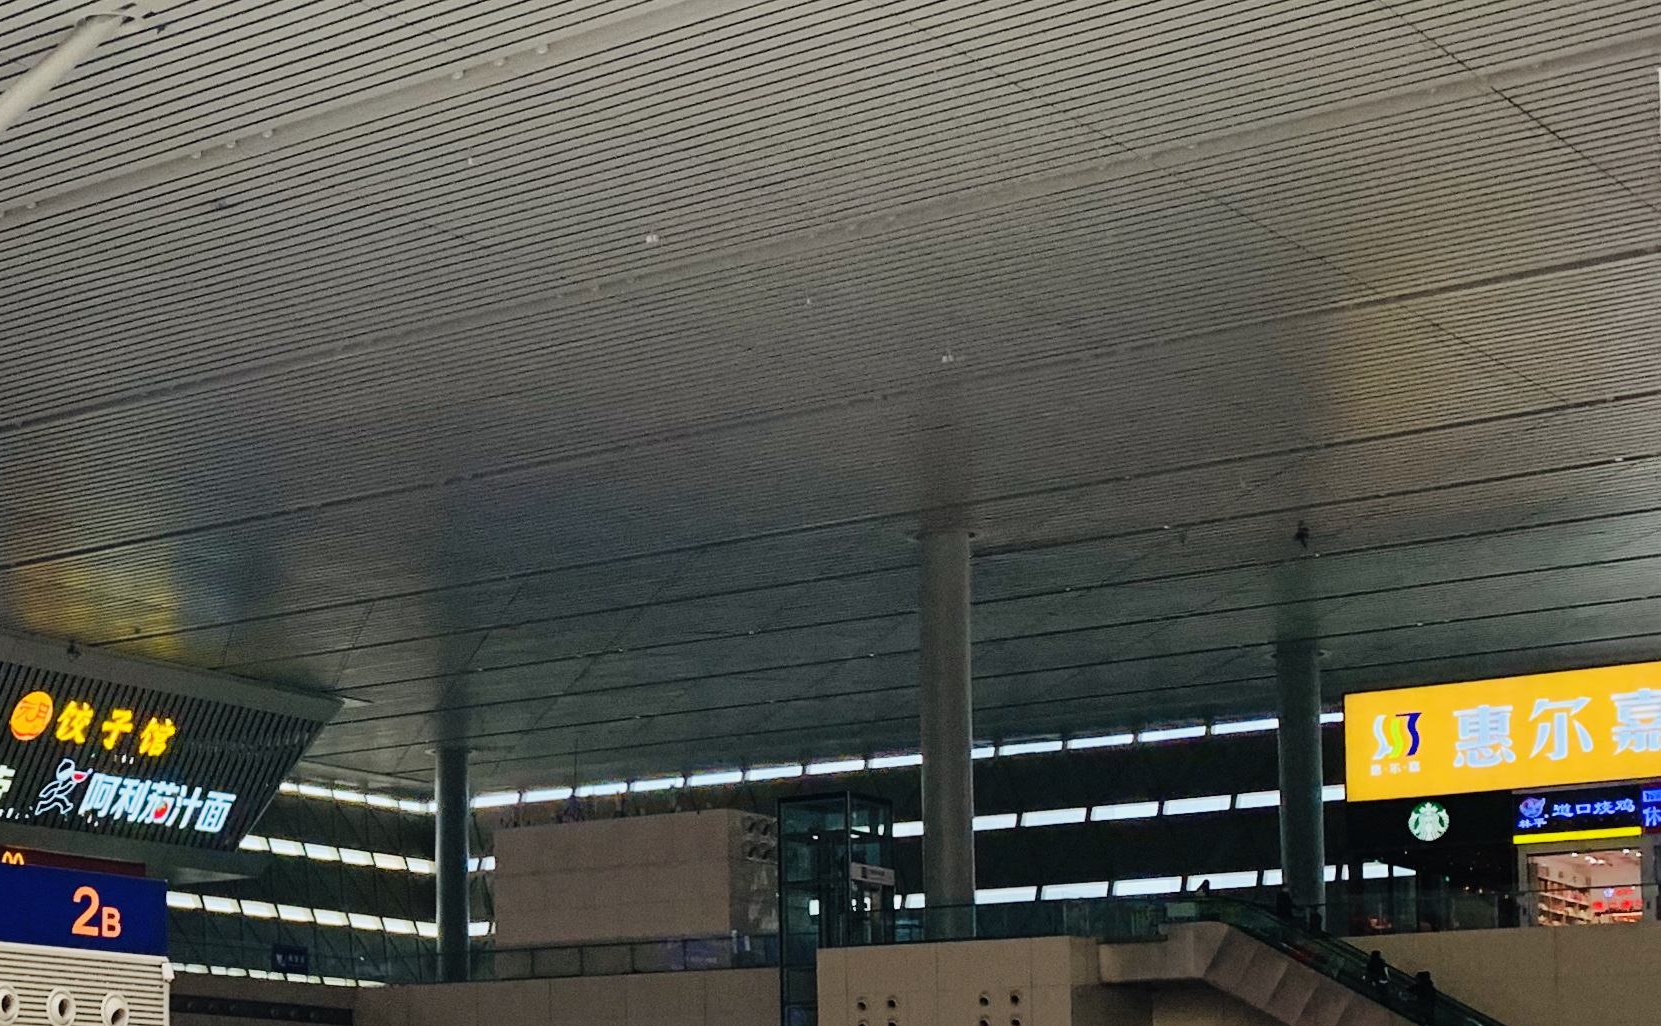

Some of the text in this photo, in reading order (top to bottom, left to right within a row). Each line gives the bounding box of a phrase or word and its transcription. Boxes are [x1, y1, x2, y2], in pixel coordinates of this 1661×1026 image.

[55, 700, 176, 757] 饺子馆
[1452, 687, 1661, 769] 惠尔嘉
[78, 772, 237, 833] 阿利茄汁面
[1518, 817, 1548, 829] 林平
[1551, 798, 1636, 818] 道口烧鸡
[72, 886, 121, 938] 2B
